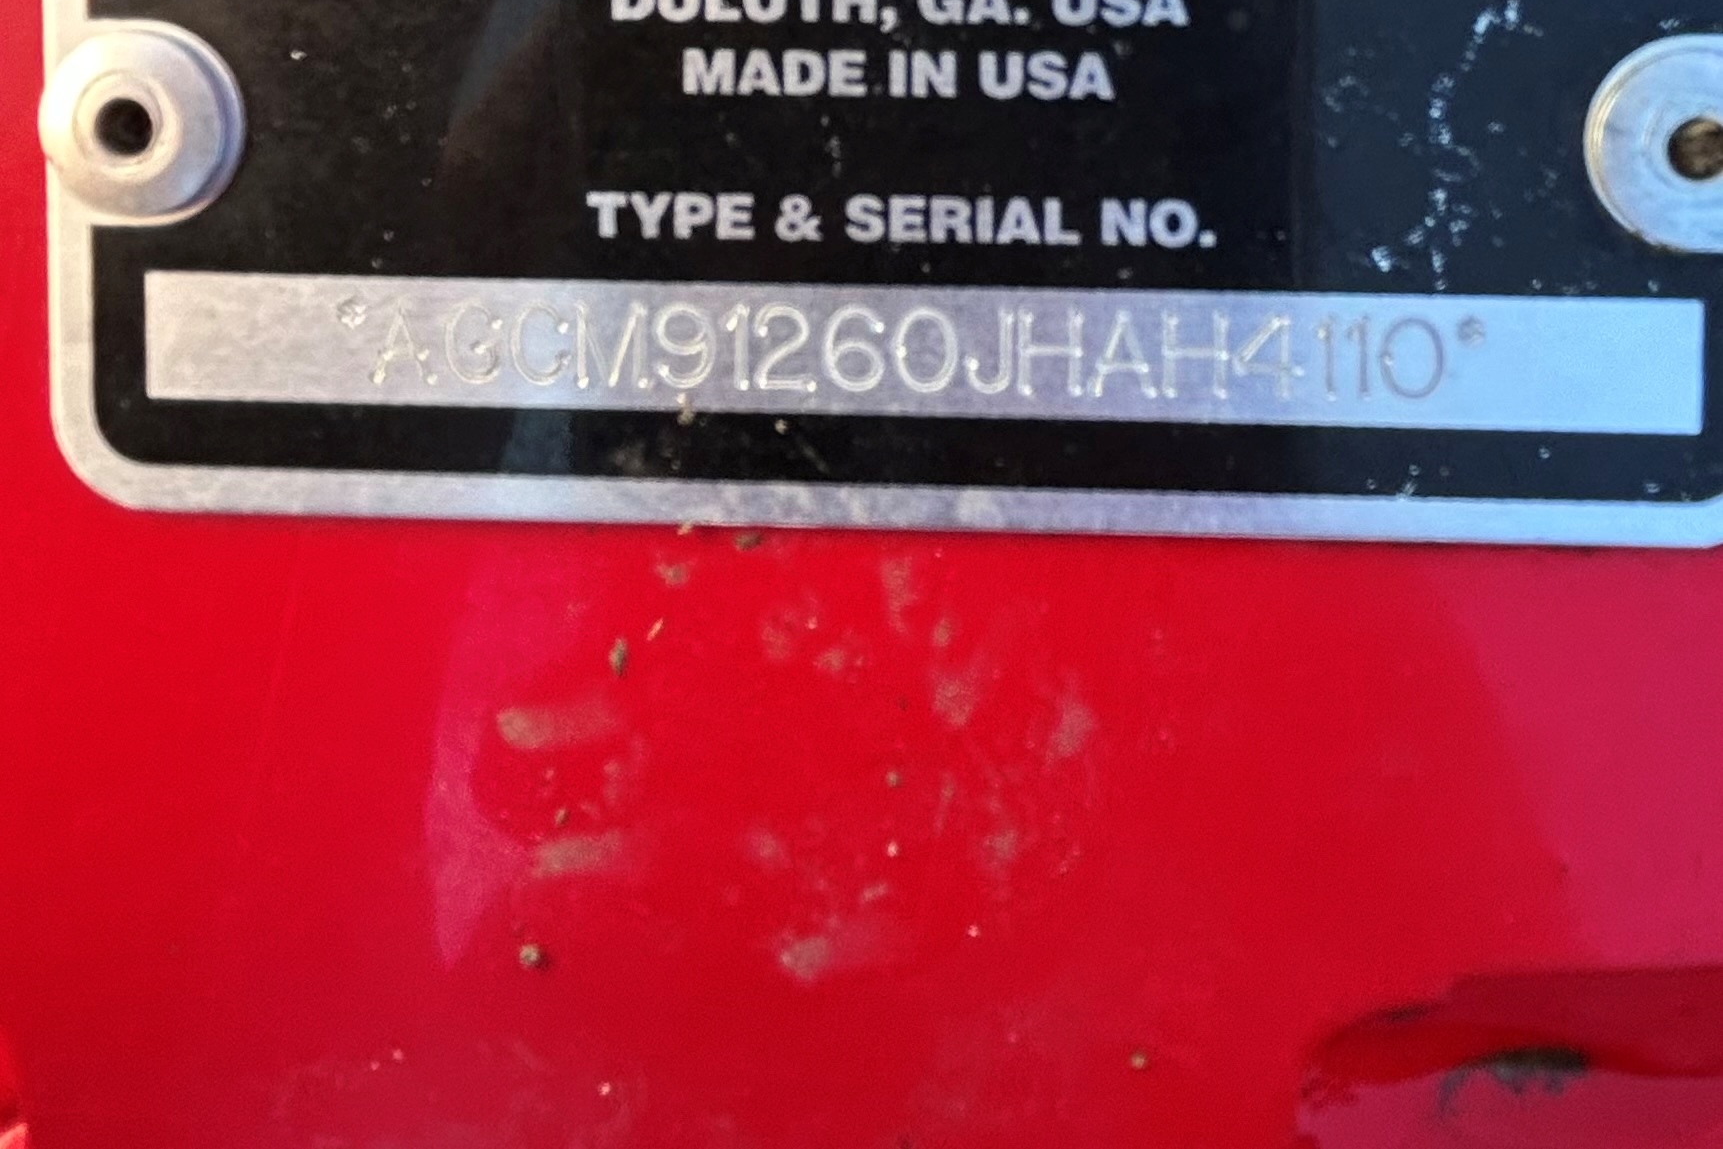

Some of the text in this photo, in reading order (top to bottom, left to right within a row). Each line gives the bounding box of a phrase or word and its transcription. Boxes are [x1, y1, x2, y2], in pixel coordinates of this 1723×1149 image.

[683, 48, 1114, 99] MADE IN USA
[587, 192, 1215, 247] TYPE & SERIAL NO.
